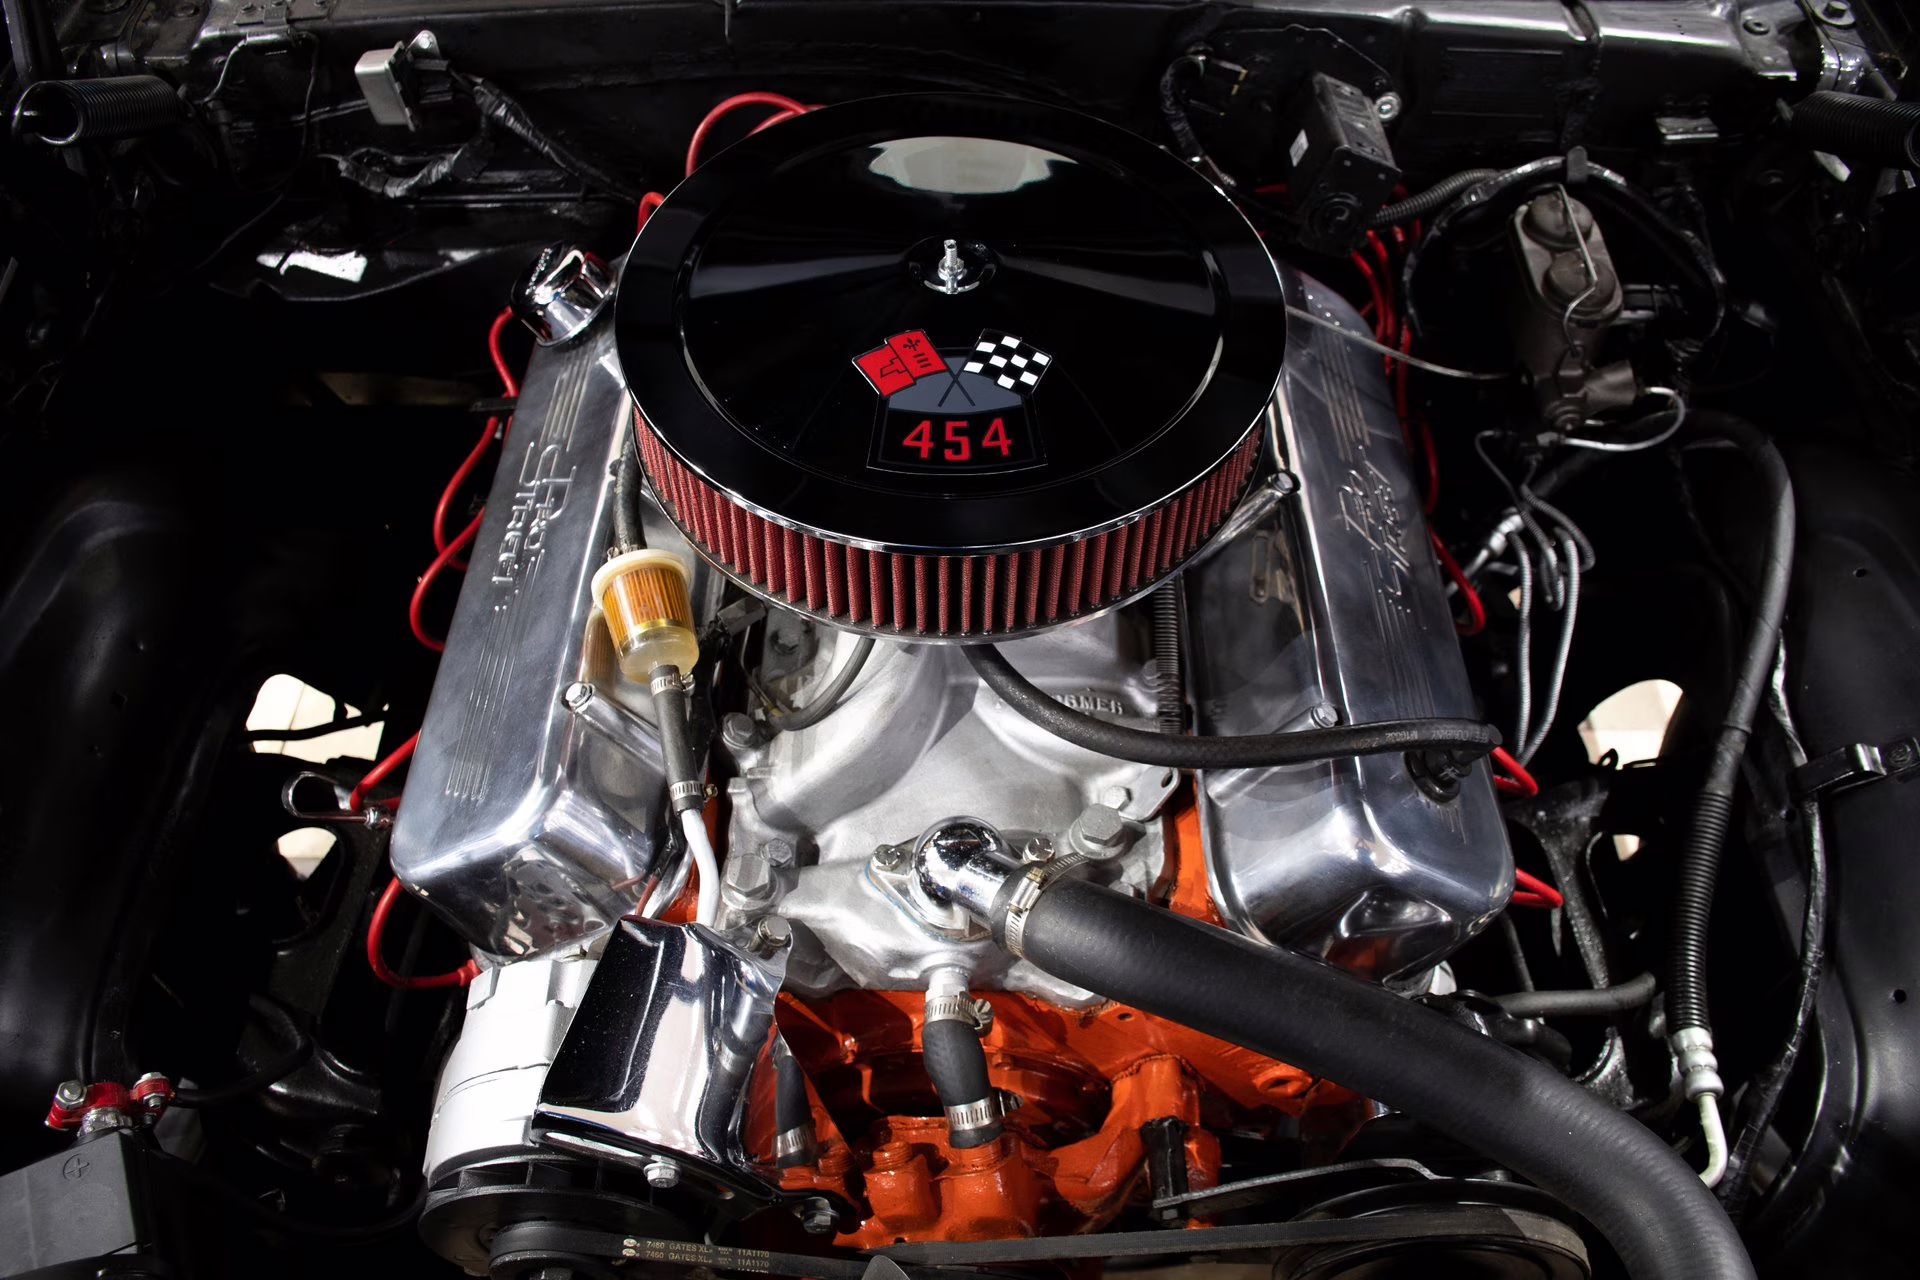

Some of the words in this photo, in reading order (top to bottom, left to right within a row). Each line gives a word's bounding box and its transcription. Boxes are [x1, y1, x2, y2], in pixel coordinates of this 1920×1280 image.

[902, 417, 1013, 461] 454
[669, 1243, 697, 1252] GATES
[668, 1253, 695, 1262] GATES
